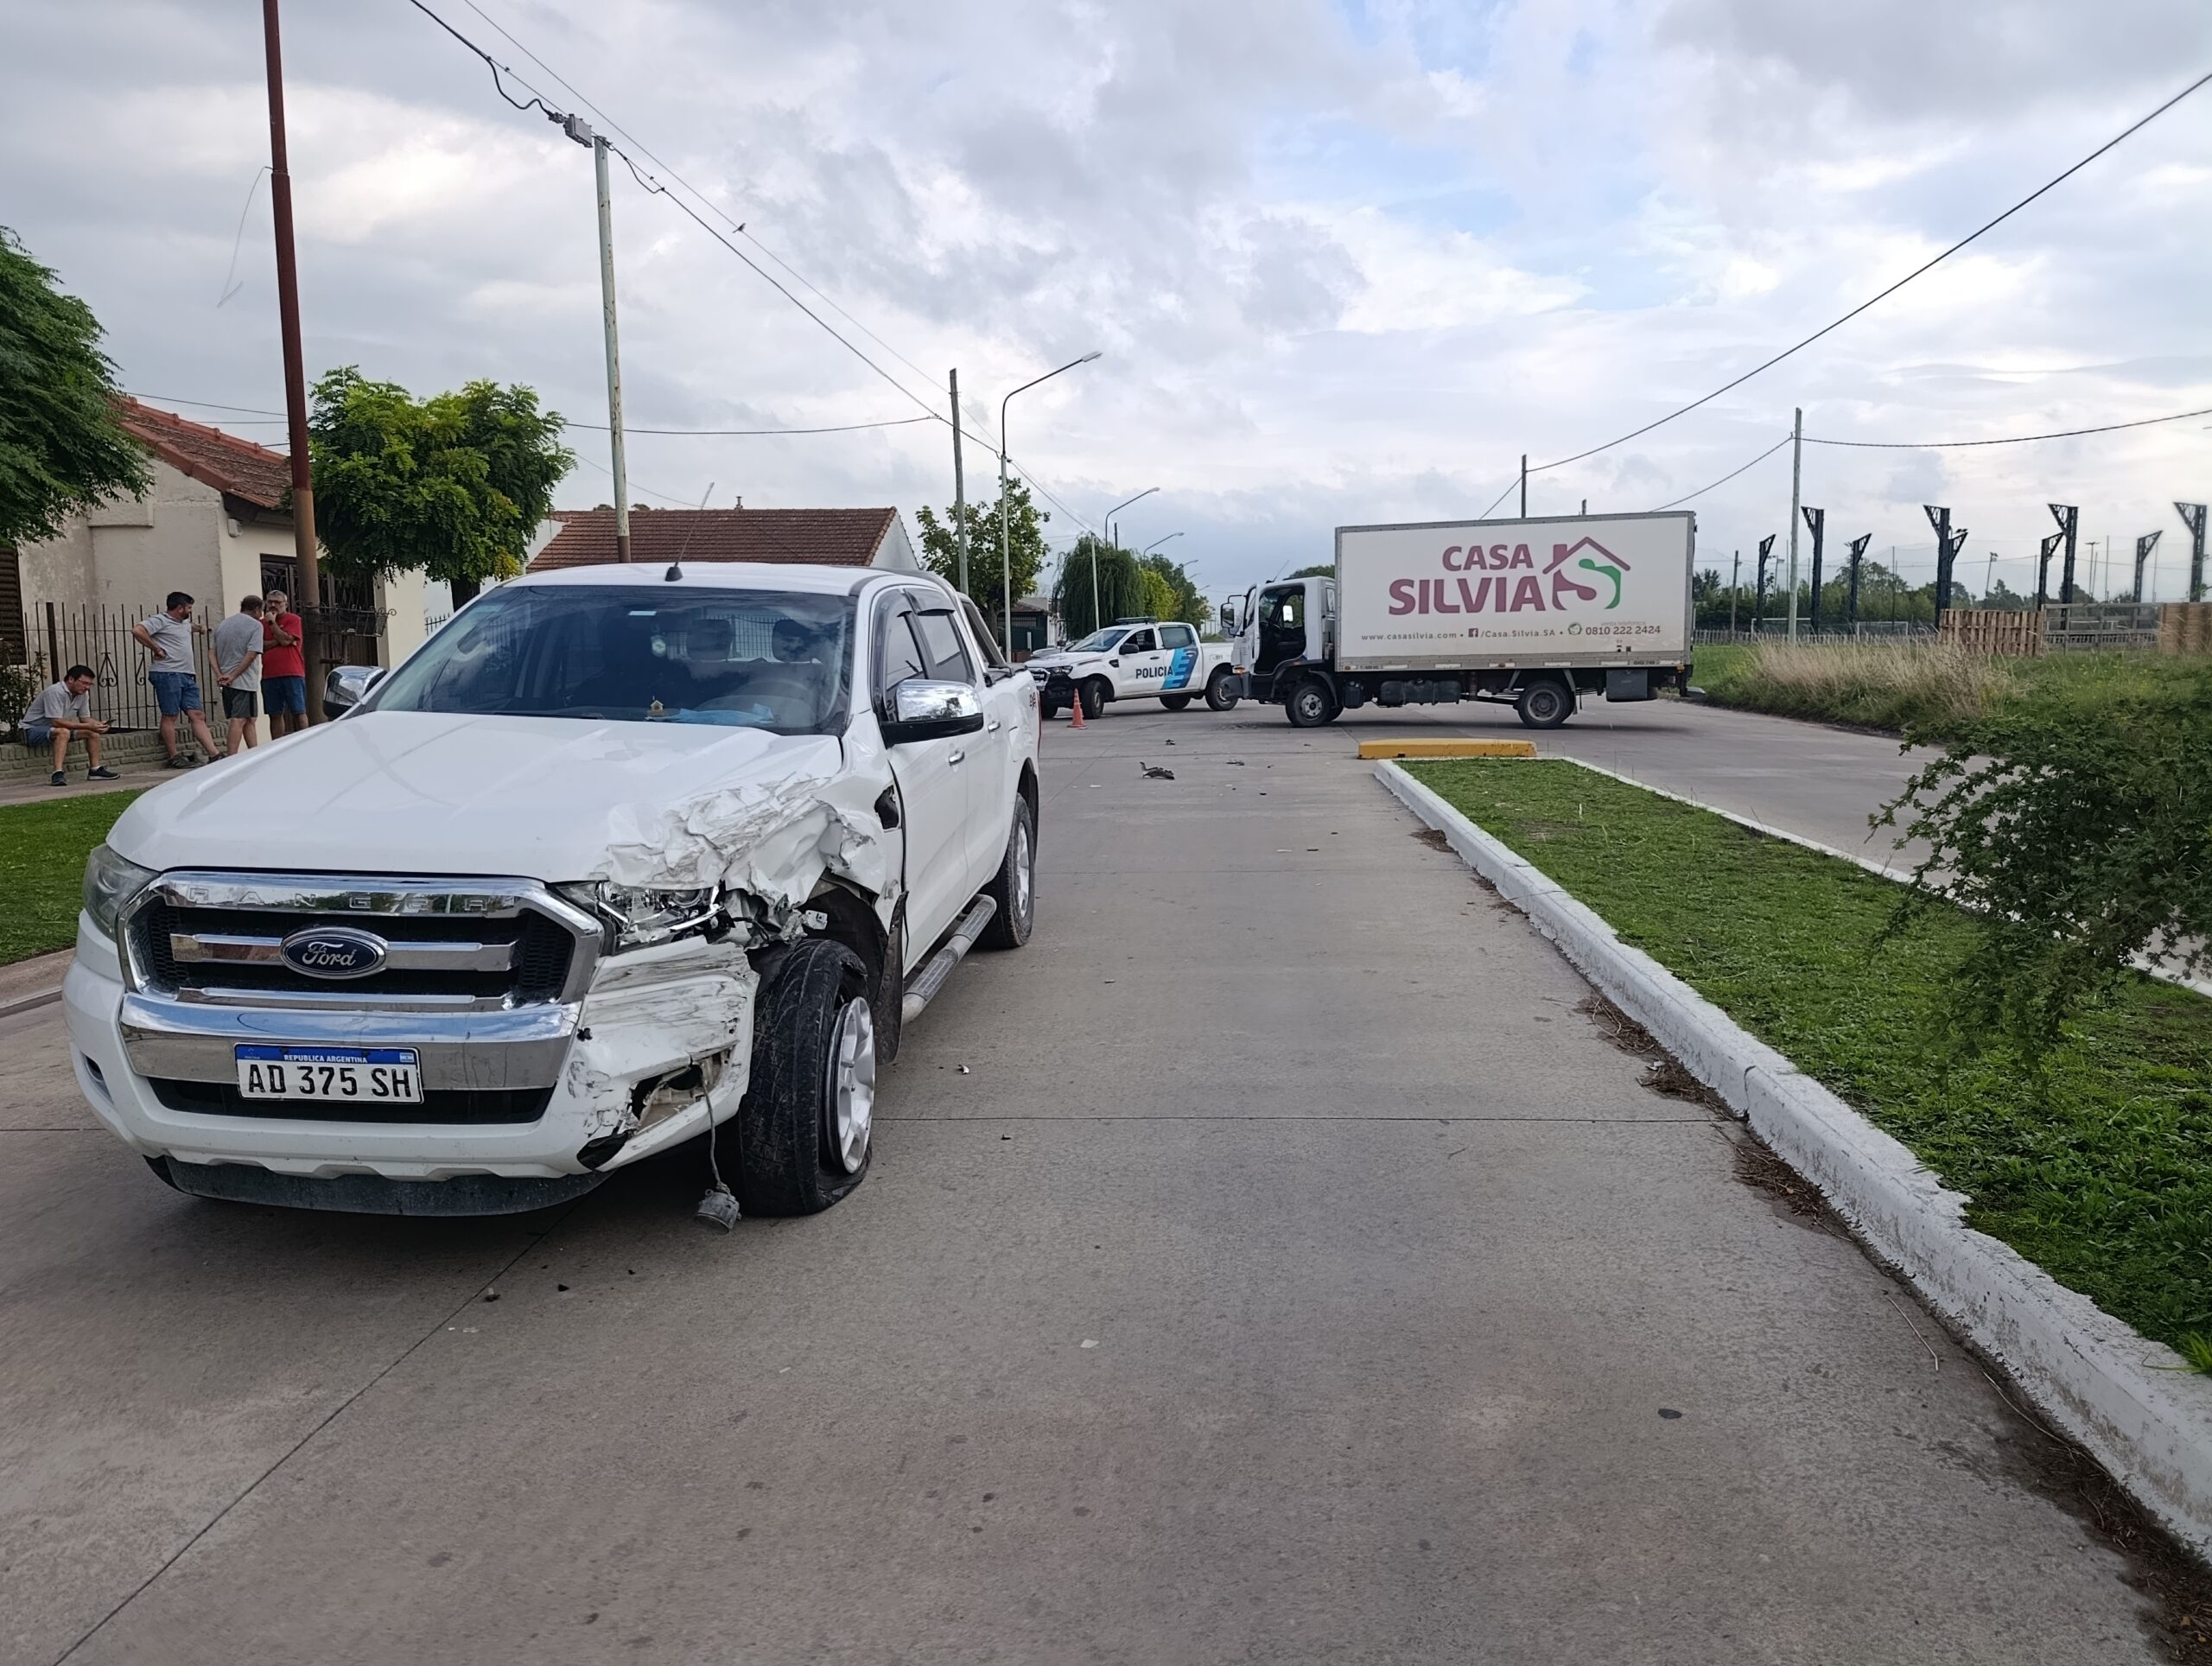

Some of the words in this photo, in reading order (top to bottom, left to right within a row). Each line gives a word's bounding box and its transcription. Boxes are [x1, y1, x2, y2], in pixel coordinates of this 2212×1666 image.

[1442, 544, 1534, 572] CASA
[1389, 575, 1547, 615] SILVIA
[1361, 631, 1457, 641] www.casasilvia.com
[1586, 626, 1611, 635] 0810
[1613, 626, 1632, 635] 222
[1635, 625, 1661, 634] 2424
[1135, 666, 1173, 679] POLICIA
[188, 887, 487, 913] RANGER
[302, 941, 358, 967] Ford
[283, 1054, 325, 1063] REPUBLICA
[326, 1055, 368, 1064] ARGENTINA
[248, 1064, 287, 1094] AD
[296, 1065, 358, 1097] 375
[371, 1067, 412, 1098] SH
